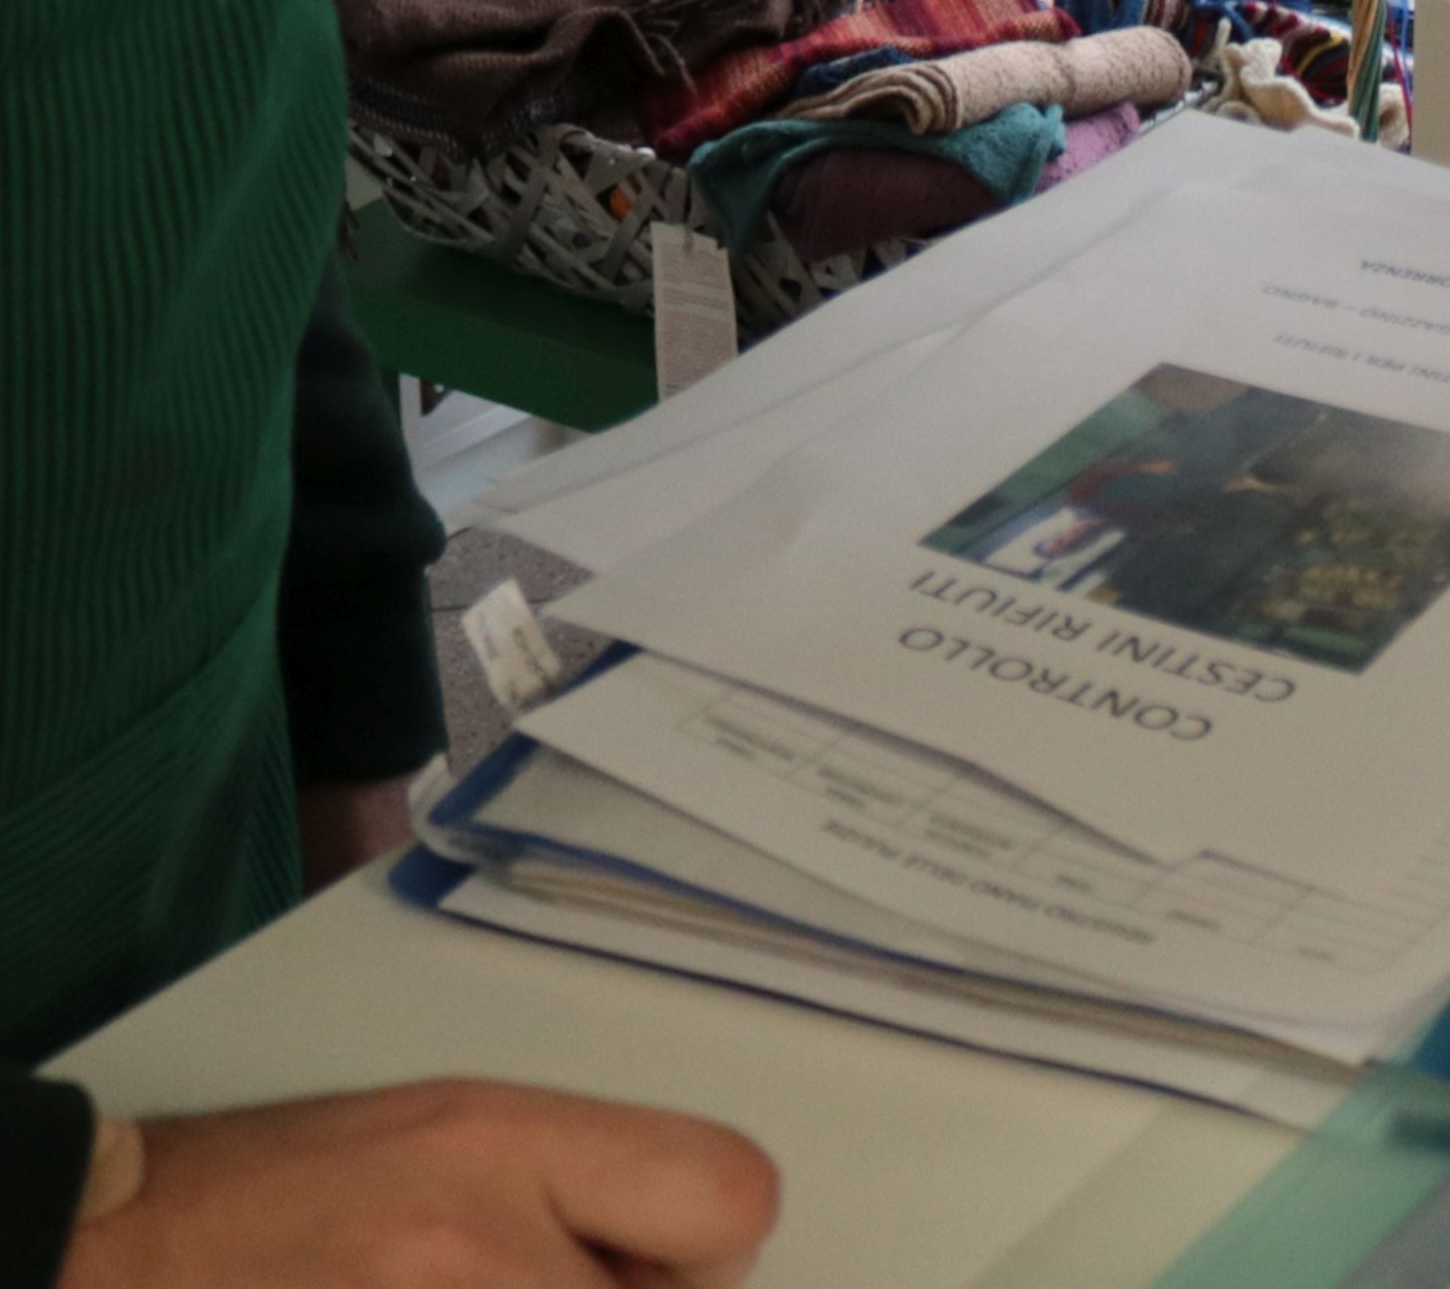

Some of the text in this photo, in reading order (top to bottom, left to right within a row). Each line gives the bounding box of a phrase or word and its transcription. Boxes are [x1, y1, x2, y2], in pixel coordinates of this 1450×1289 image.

[1261, 285, 1338, 308] BAGNO
[1273, 334, 1348, 358] RIFIUTI
[909, 570, 1295, 701] CESTINI RIFIUTI
[899, 627, 1211, 739] CONTROLLO
[902, 854, 967, 882] DELLE
